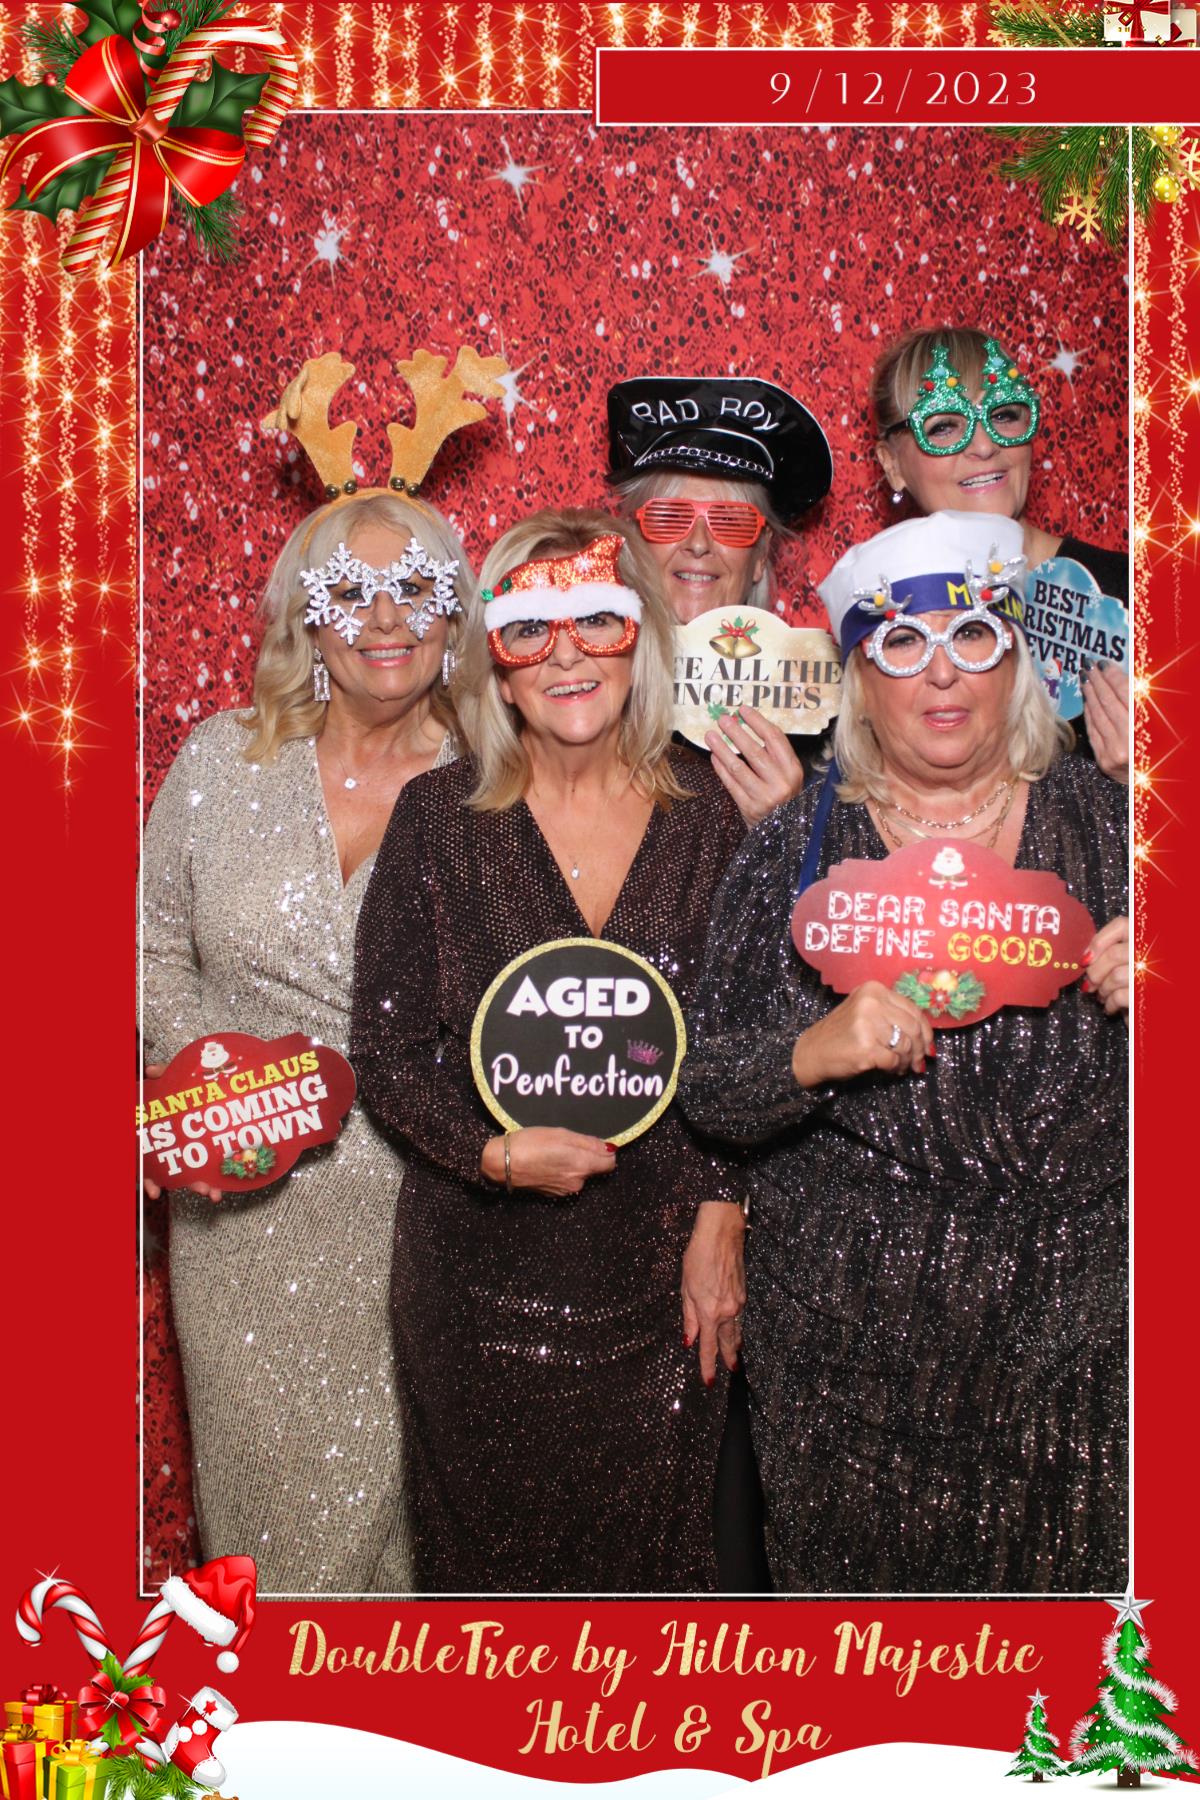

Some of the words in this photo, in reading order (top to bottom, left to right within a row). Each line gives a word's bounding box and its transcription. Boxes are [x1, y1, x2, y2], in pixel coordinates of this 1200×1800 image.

[631, 399, 699, 426] BAD
[720, 397, 780, 431] BOY
[1033, 579, 1090, 619] BEST
[710, 658, 769, 682] ALL
[777, 659, 842, 684] THE
[752, 685, 822, 709] PIES
[828, 890, 926, 926] DEAR
[938, 899, 1061, 936] SANTA
[804, 921, 936, 960] DEFINE
[947, 932, 1079, 969] GOOD...
[506, 974, 650, 1018] AGED
[564, 1025, 603, 1049] TO
[229, 1050, 320, 1094] CLAUS
[491, 1053, 664, 1097] Perfection
[181, 1073, 328, 1139] COMING
[157, 1142, 209, 1177] TO
[212, 1104, 324, 1159] TOWN
